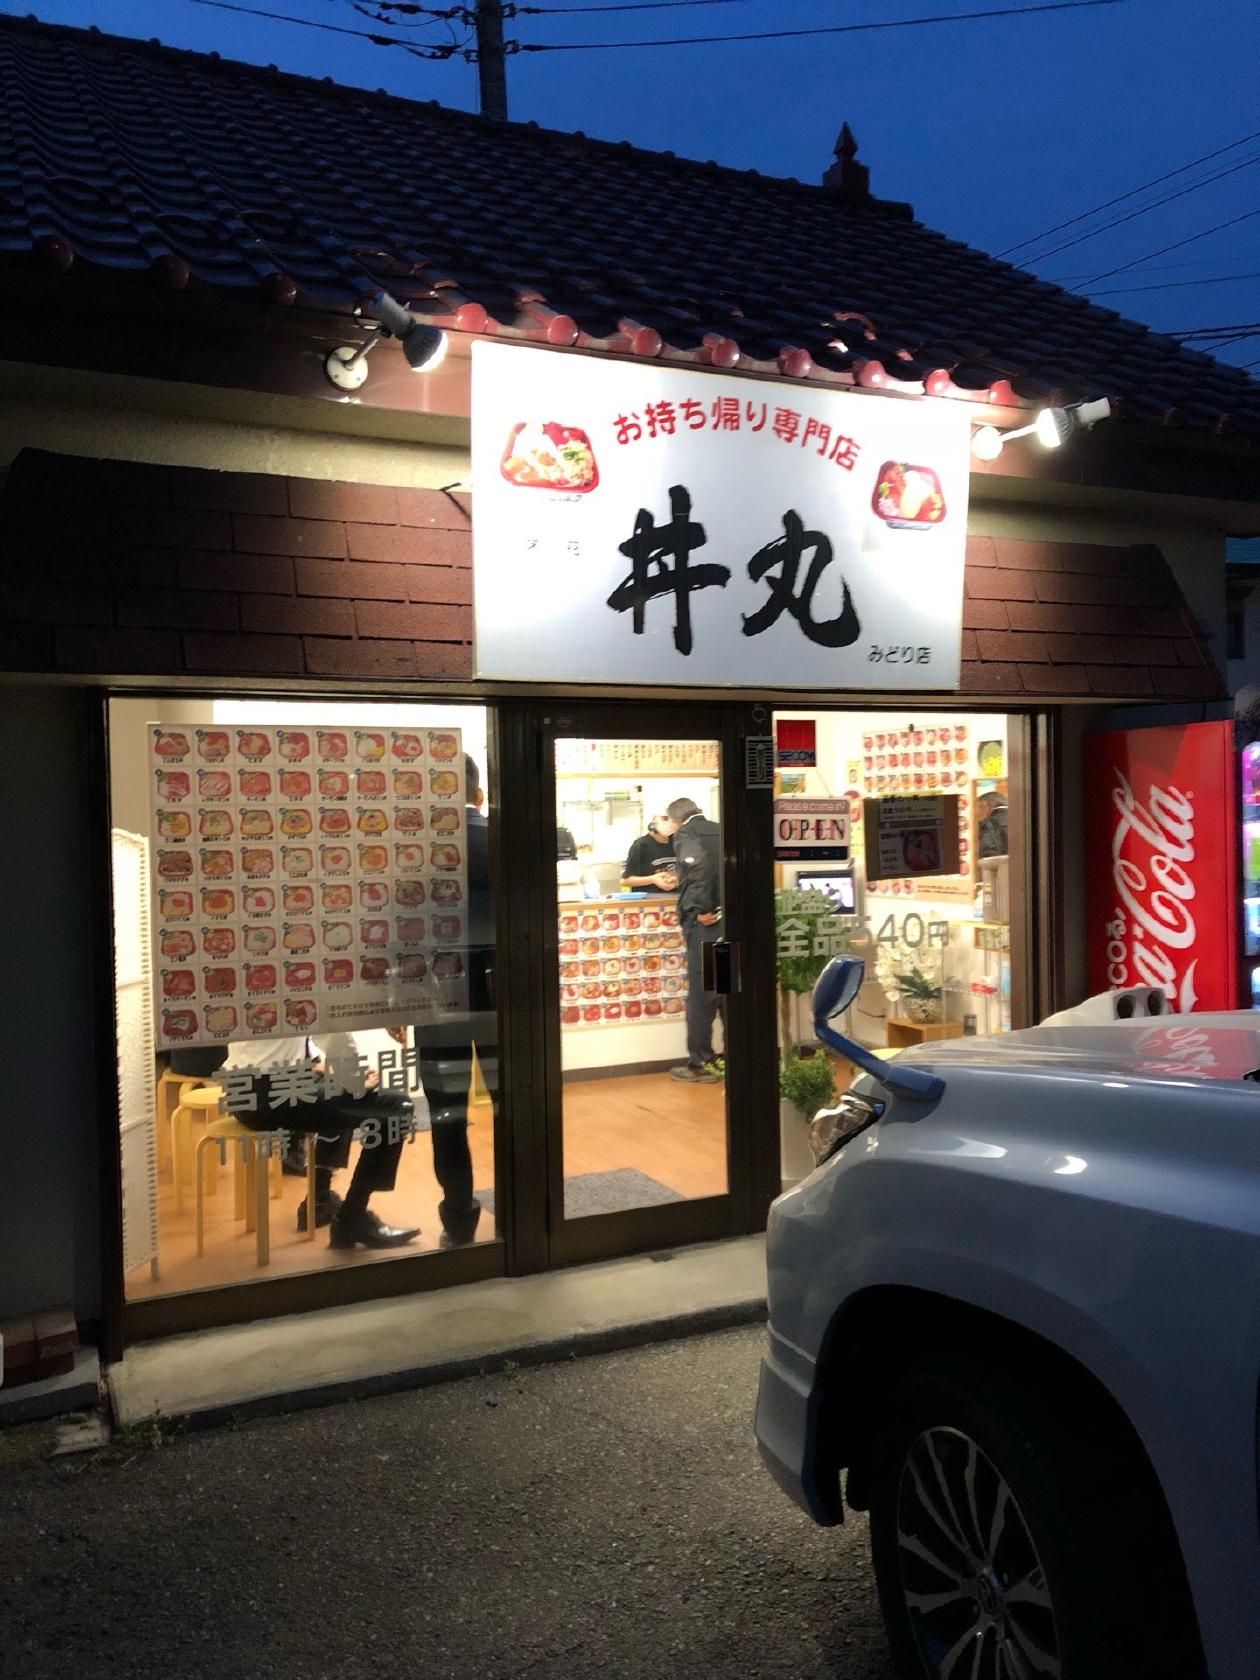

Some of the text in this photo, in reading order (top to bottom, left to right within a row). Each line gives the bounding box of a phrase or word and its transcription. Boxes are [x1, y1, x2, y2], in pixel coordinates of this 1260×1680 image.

[612, 396, 862, 472] お持ち帰り専門店
[868, 644, 932, 664] みどり店
[779, 819, 845, 841] OPEN
[1112, 766, 1196, 1000] a-Cola
